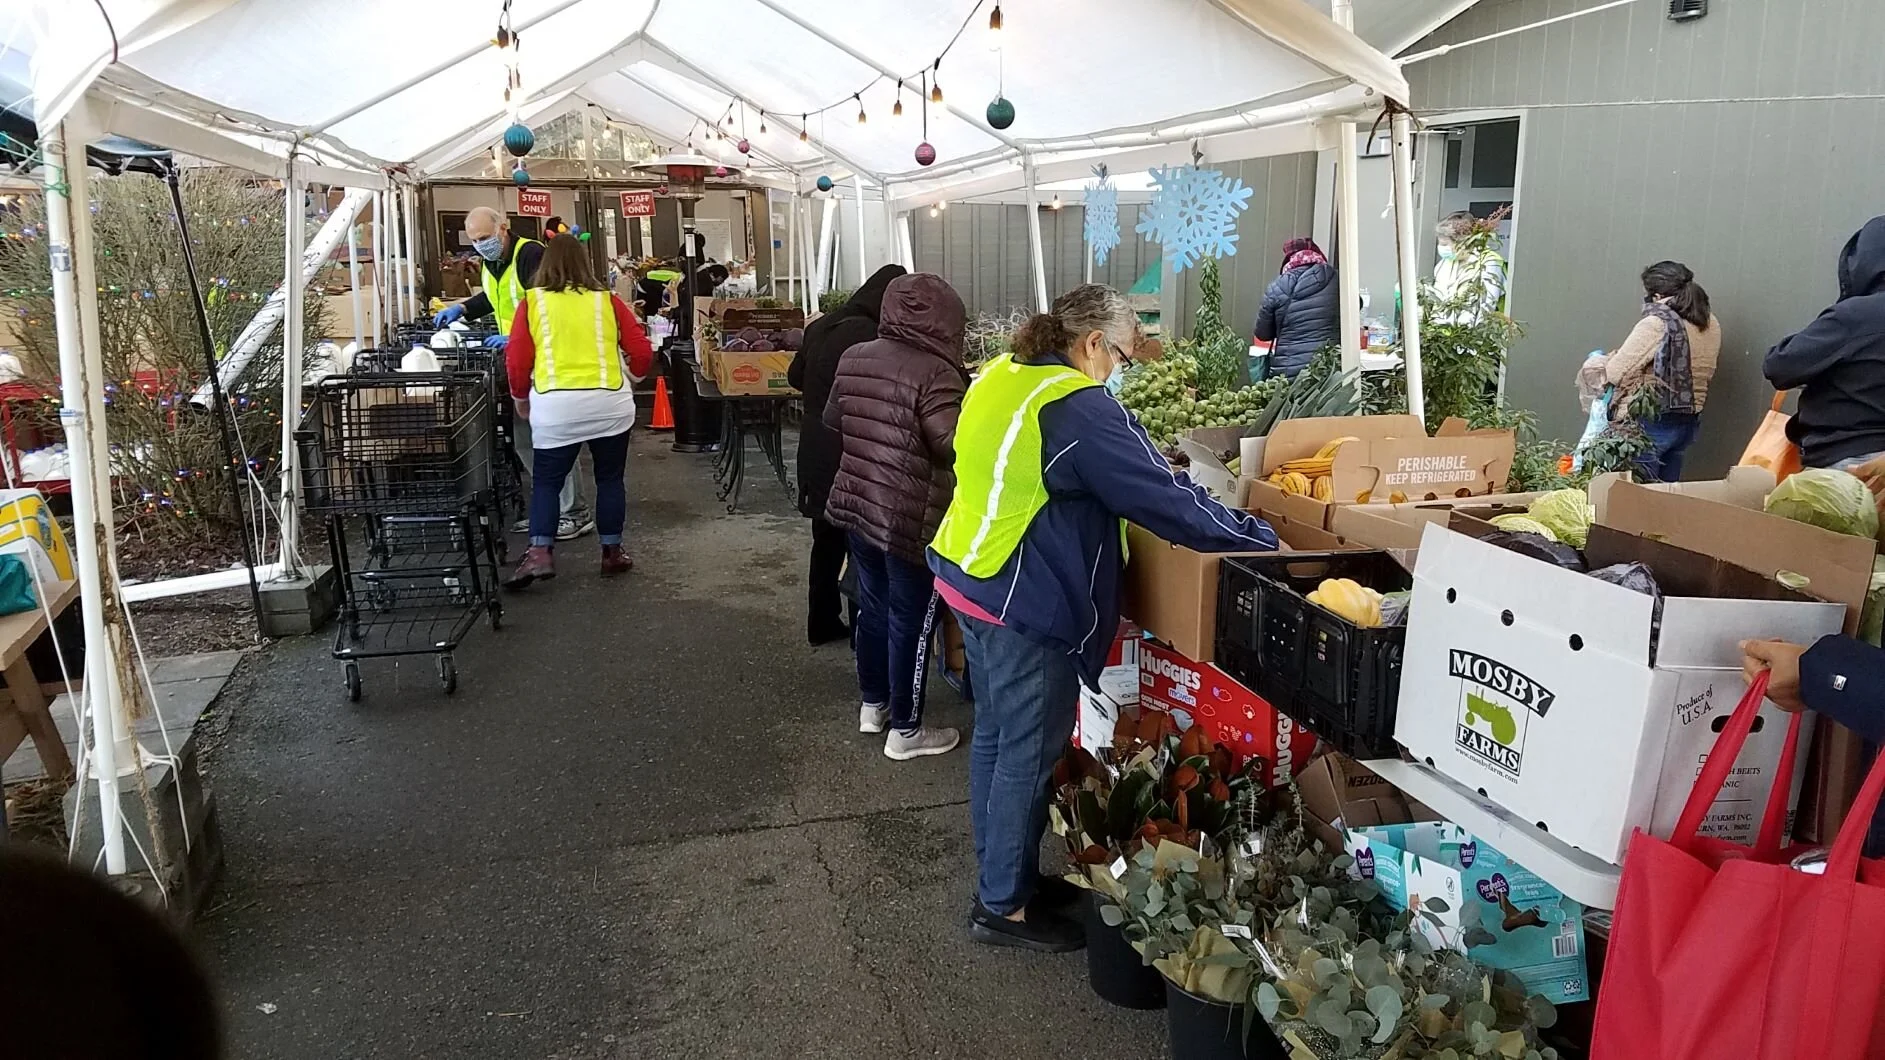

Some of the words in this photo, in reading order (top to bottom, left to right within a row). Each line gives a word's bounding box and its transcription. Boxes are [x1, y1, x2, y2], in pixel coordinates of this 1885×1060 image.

[521, 193, 547, 203] STAFF
[625, 194, 650, 203] STAFF
[522, 204, 547, 213] ONLY
[627, 204, 650, 214] ONLY
[1397, 455, 1467, 472] PERISHABLE
[1385, 472, 1409, 485] KEEP
[1410, 469, 1477, 484] REFRIGERATED
[1140, 647, 1201, 690] HUGGIES
[1452, 651, 1551, 712] MOSBY
[1676, 694, 1705, 715] Produce
[1705, 683, 1713, 698] of
[1682, 700, 1713, 726] U.S.A.
[1458, 725, 1519, 771] FARMS
[1455, 747, 1518, 784] www.mosbyfarm.com
[1736, 767, 1761, 775] BEETS
[1348, 775, 1385, 788] ROZEN
[1737, 813, 1753, 821] INC.
